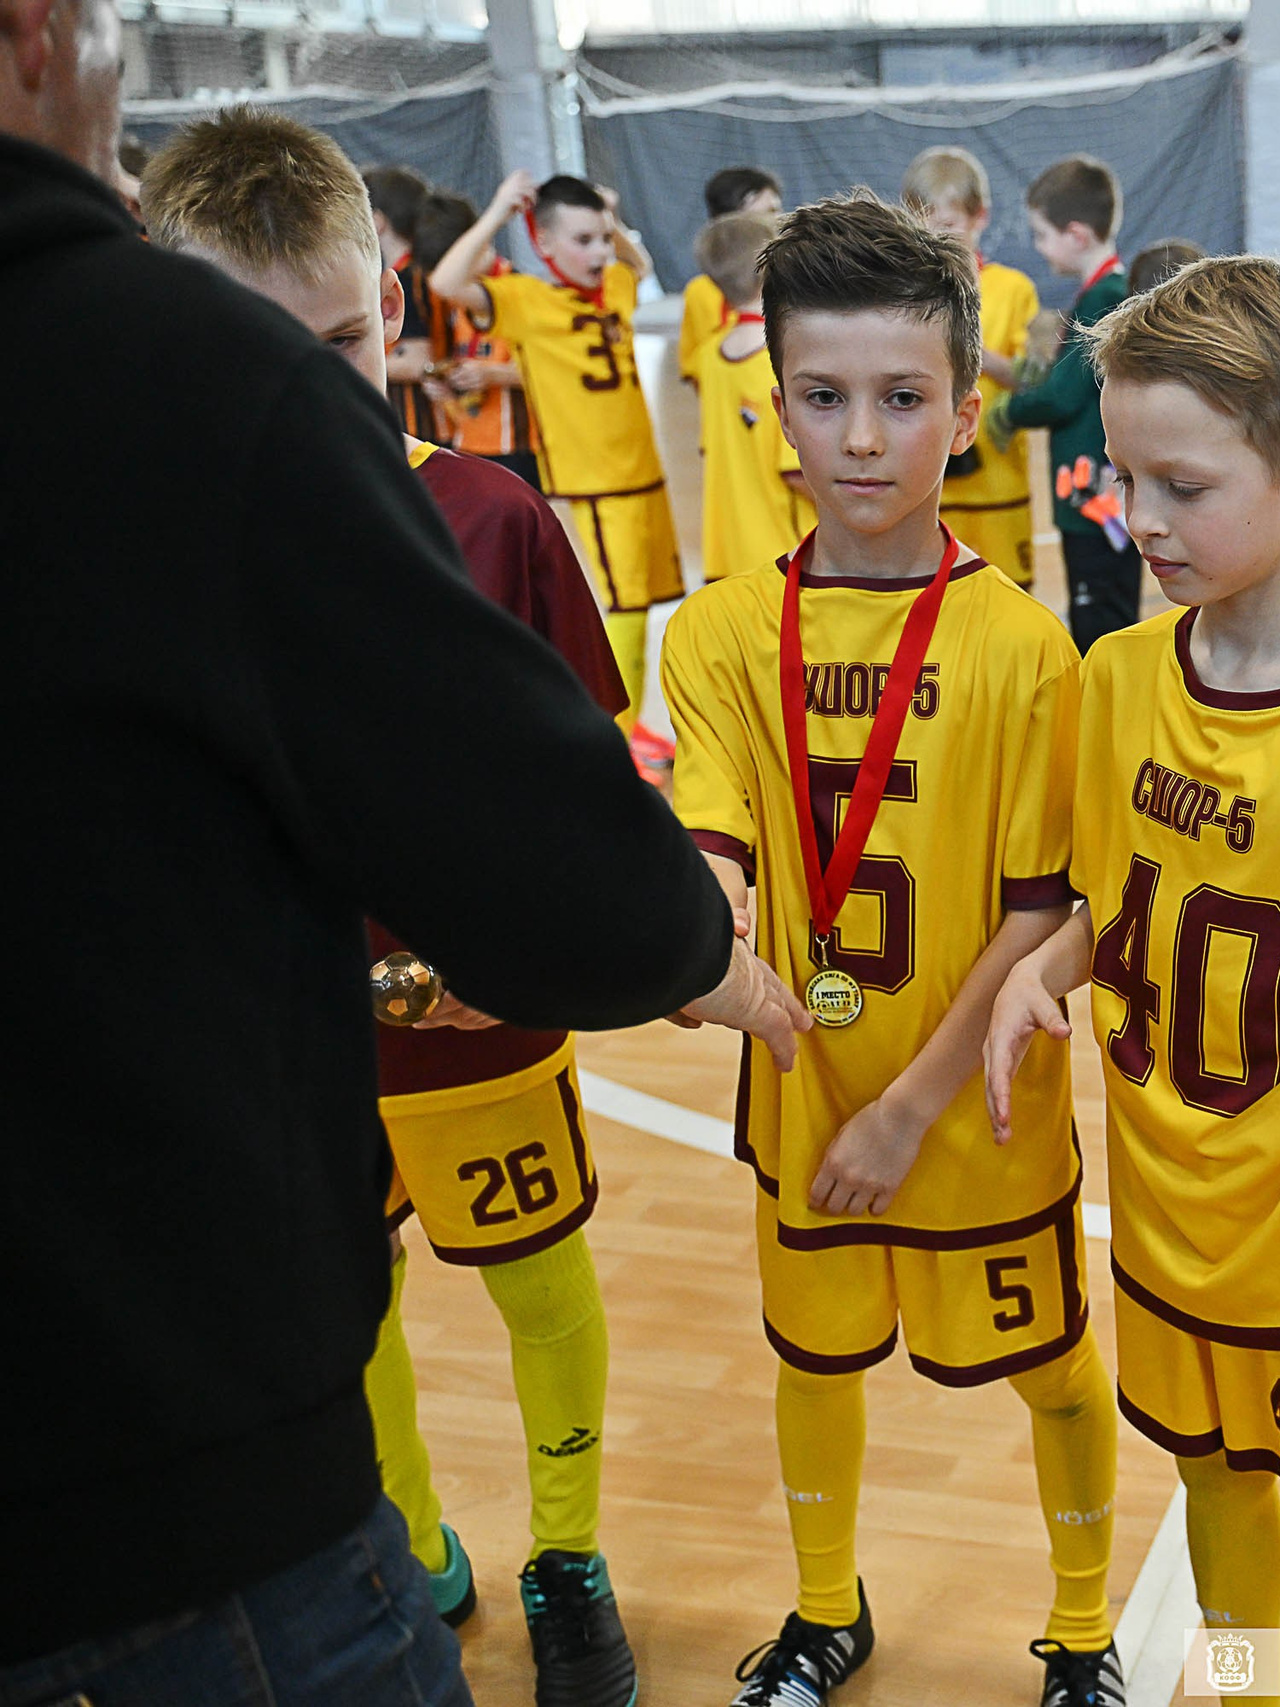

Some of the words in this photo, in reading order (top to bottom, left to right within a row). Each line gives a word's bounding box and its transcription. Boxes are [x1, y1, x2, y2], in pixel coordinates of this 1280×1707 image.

[1131, 757, 1257, 854] СШОР-5
[807, 753, 918, 996] 5
[456, 1141, 559, 1227] 26
[984, 1255, 1035, 1333] 5
